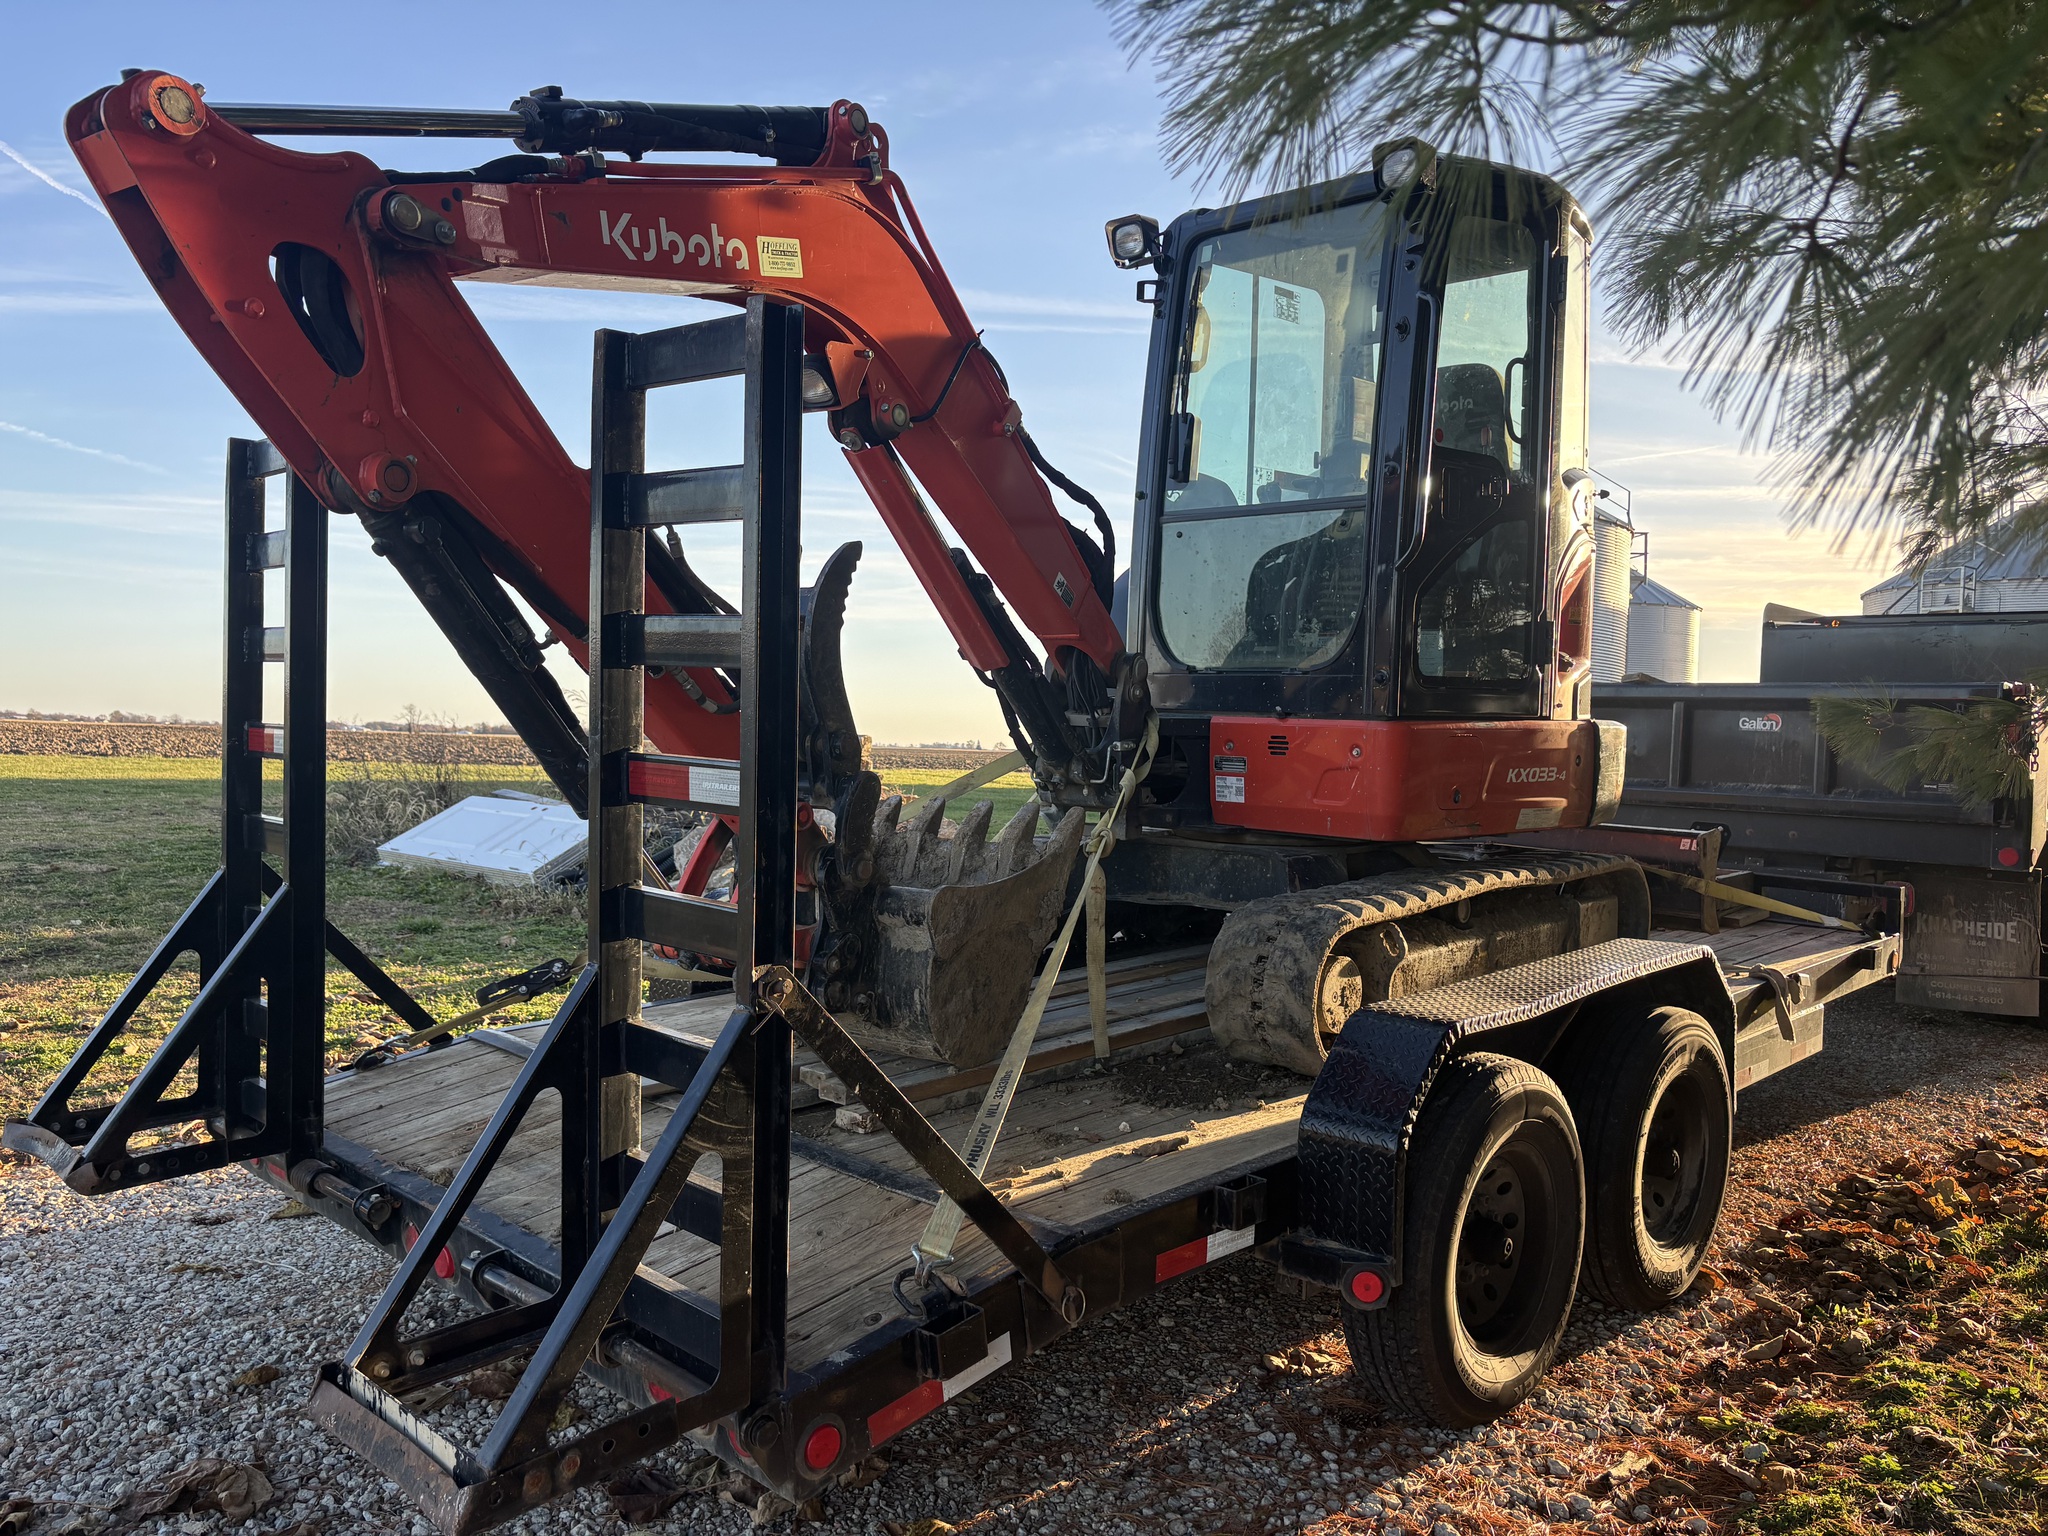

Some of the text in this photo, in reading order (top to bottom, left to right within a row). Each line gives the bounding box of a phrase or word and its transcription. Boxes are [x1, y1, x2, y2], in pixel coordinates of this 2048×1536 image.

[600, 210, 750, 271] Kubota
[1739, 716, 1776, 731] Galion
[1506, 767, 1566, 783] KX033-4
[1916, 911, 2018, 943] KNAPHEIDE
[966, 1123, 992, 1164] HUSKY
[985, 1102, 1001, 1119] WLL
